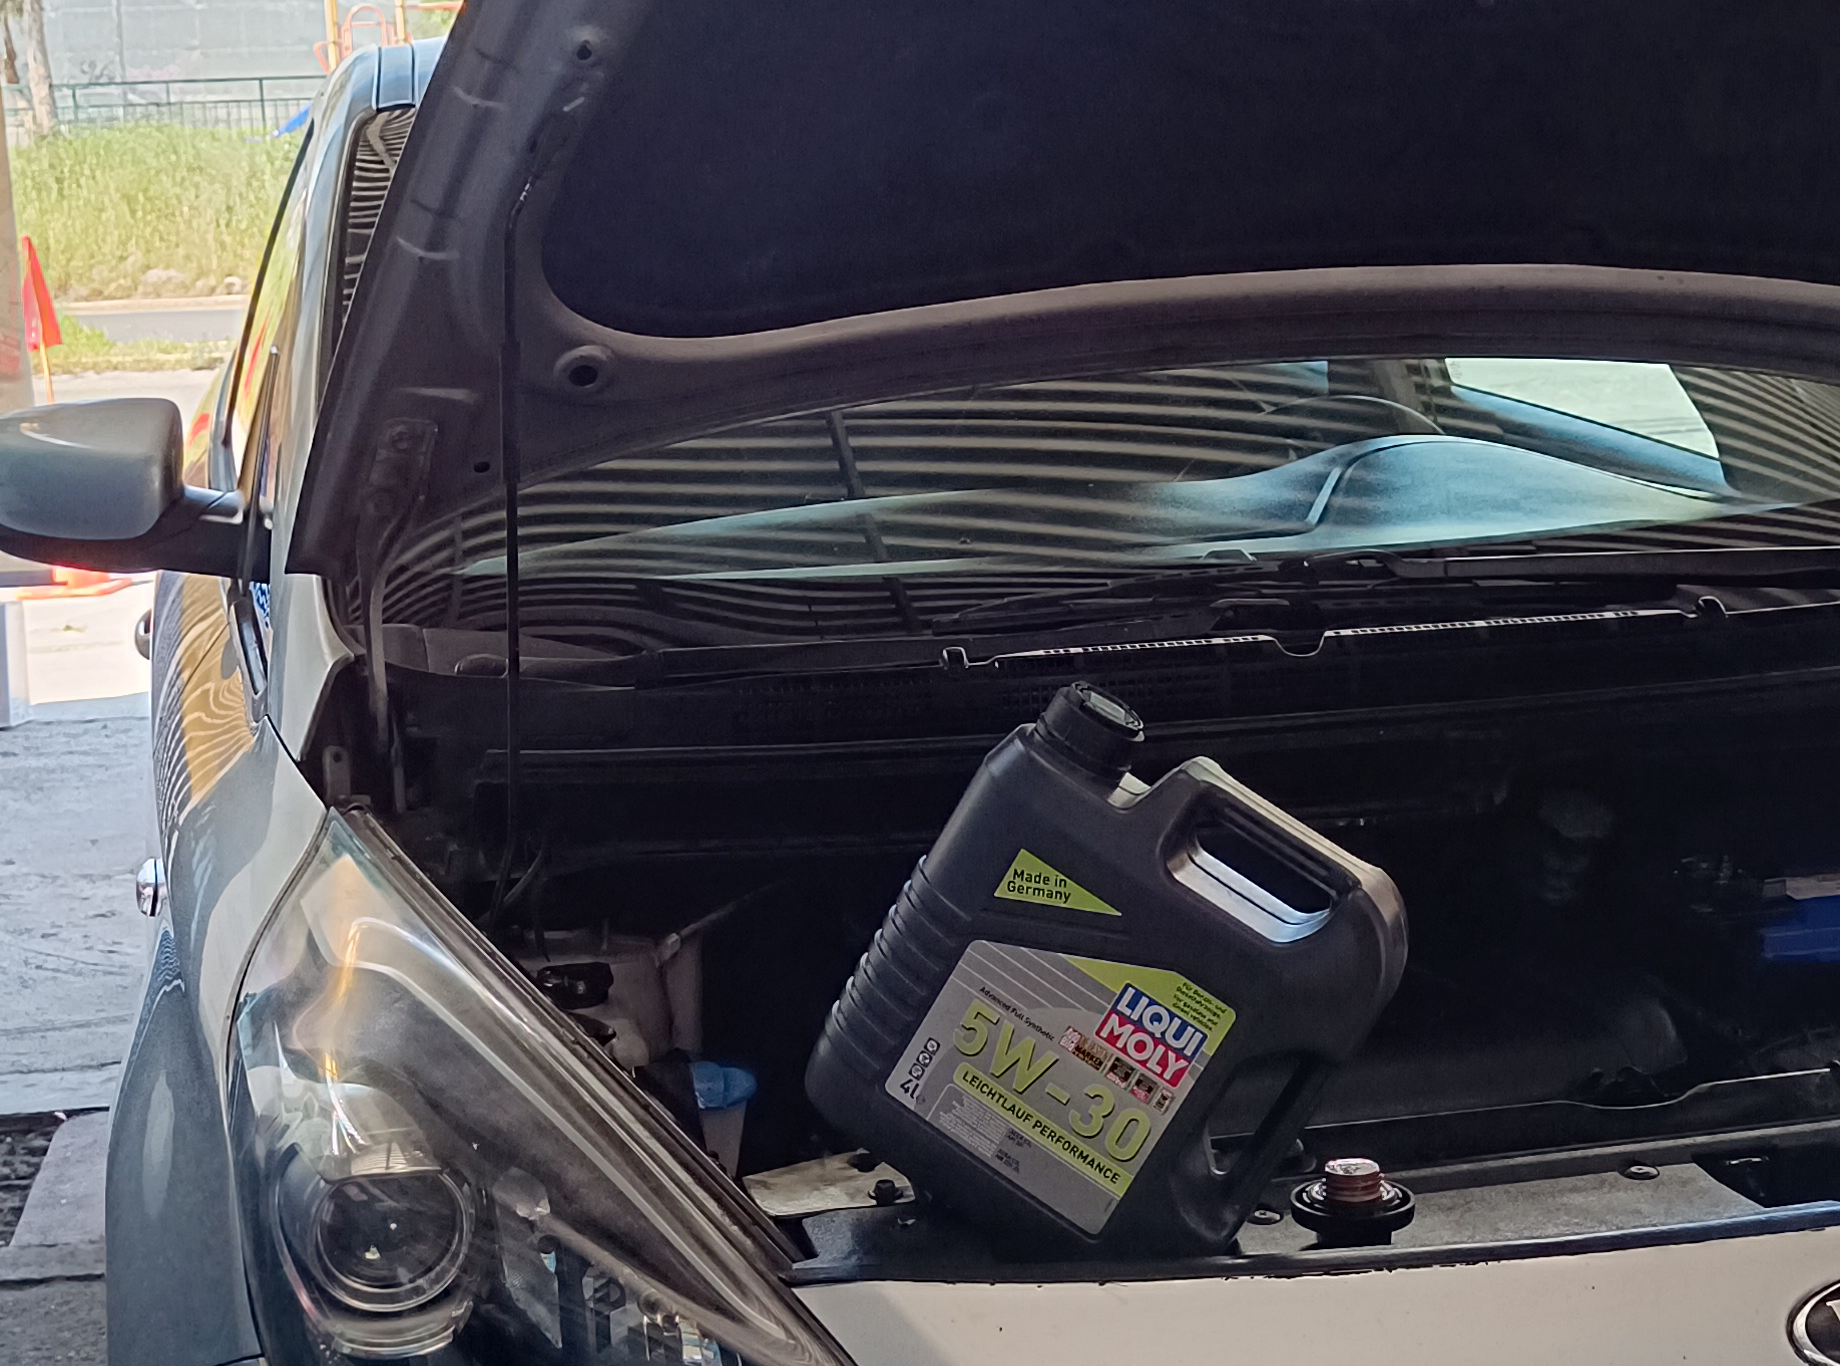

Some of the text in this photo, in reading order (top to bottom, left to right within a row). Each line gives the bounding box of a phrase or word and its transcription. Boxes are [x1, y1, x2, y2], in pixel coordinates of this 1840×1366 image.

[1007, 880, 1071, 904] Germany
[1012, 868, 1067, 889] Made in
[980, 986, 1012, 1012] Advanced
[1010, 1007, 1024, 1022] Full
[1024, 1016, 1055, 1042] Synthetic
[1100, 1013, 1190, 1081] MOLY
[1117, 987, 1204, 1057] LIQUI
[953, 998, 1151, 1162] 5W-30
[962, 1070, 1034, 1123] LEICHTLAUF
[1032, 1120, 1122, 1185] PERFORMANCE
